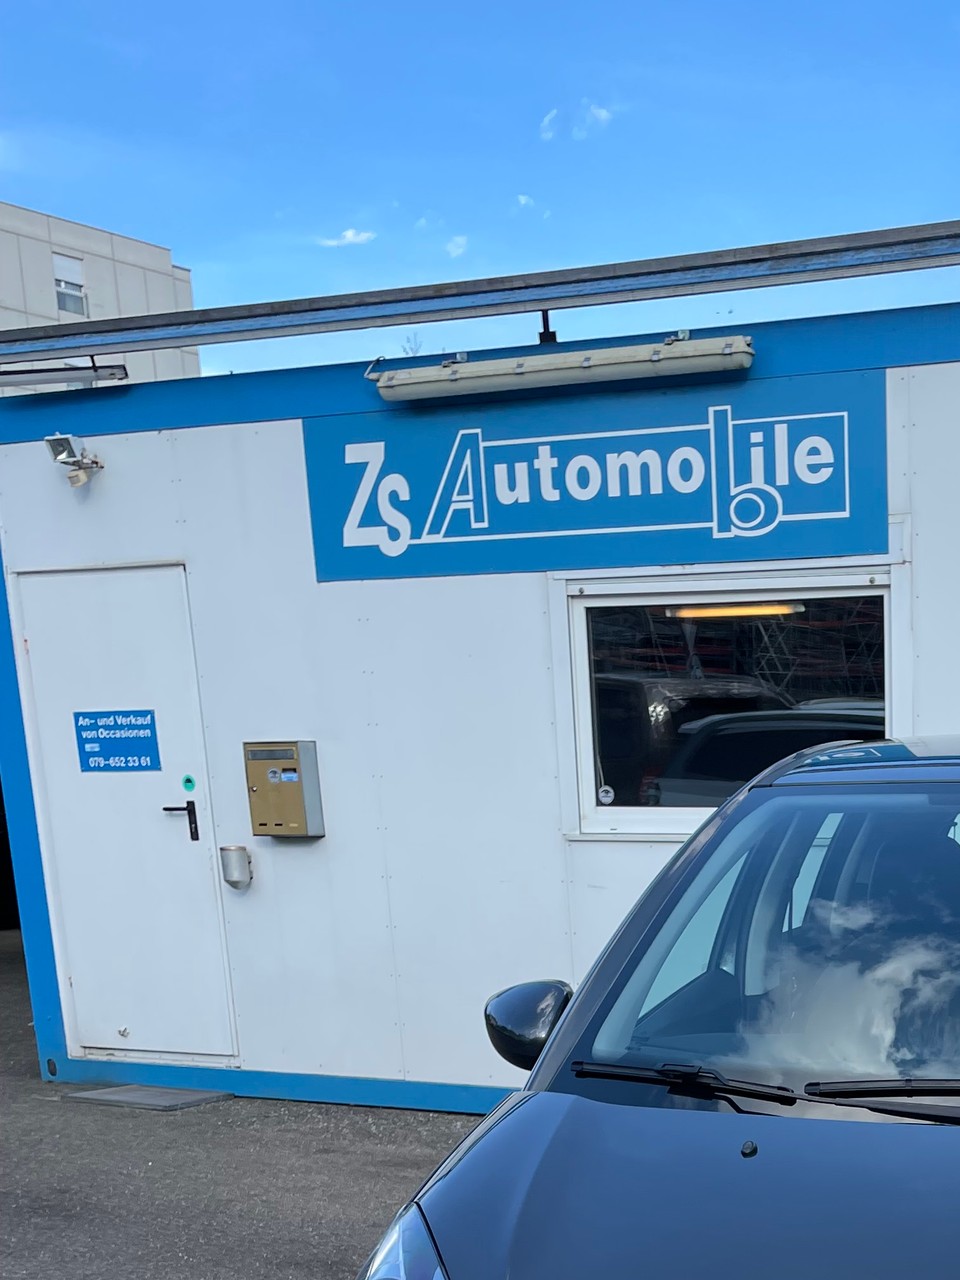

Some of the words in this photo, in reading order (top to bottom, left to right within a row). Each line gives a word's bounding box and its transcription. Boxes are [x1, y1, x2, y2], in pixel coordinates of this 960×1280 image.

[421, 405, 849, 538] Automobile
[78, 716, 95, 726] An-
[97, 716, 115, 726] und
[115, 714, 151, 725] Verkauf
[81, 730, 97, 738] von
[98, 727, 151, 738] Occasionen
[127, 756, 139, 767] 33
[140, 755, 151, 767] 61
